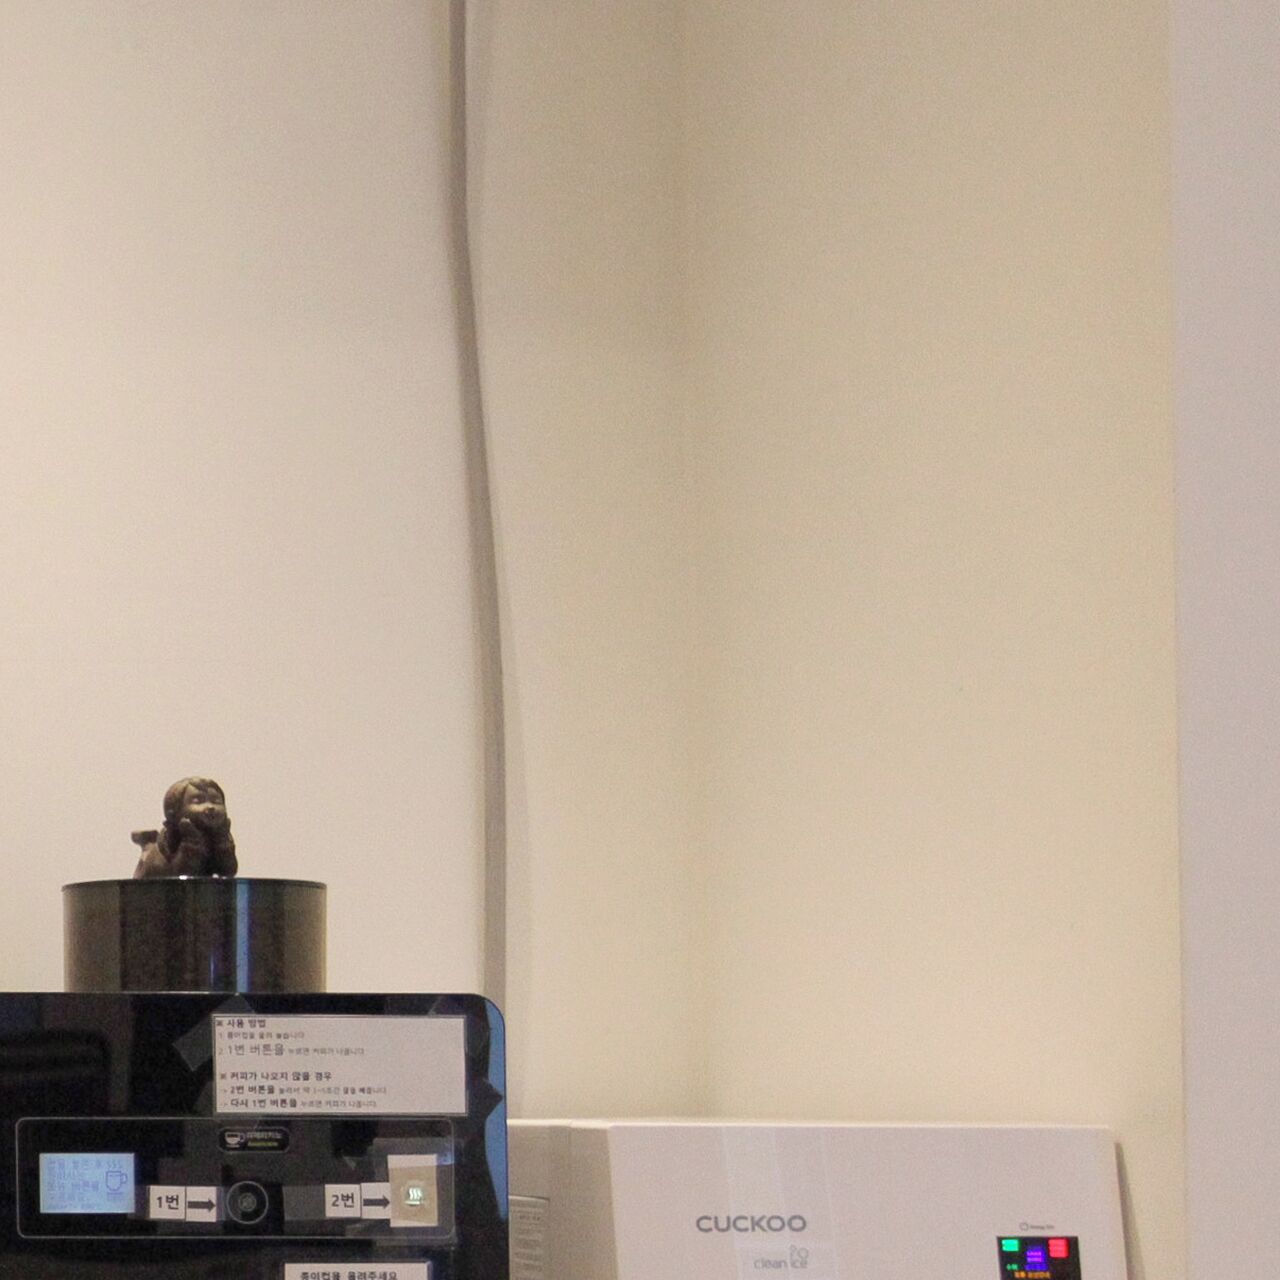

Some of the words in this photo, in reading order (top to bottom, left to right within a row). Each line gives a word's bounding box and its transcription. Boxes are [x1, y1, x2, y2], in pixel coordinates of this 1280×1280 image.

[227, 1018, 244, 1029] 사용
[248, 1018, 267, 1029] 방법
[227, 1043, 245, 1057] 1번
[249, 1042, 284, 1057] 버튼을
[230, 1071, 258, 1081] 커피가
[261, 1071, 289, 1081] 나오지
[315, 1071, 333, 1082] 경우
[230, 1085, 245, 1095] 2번
[248, 1084, 276, 1095] 버튼을
[230, 1098, 249, 1108] 다시
[253, 1098, 267, 1108] 1번
[270, 1098, 298, 1109] 버튼을
[156, 1194, 180, 1211] 1번
[330, 1192, 356, 1209] 2번
[695, 1214, 808, 1233] CUCKOO
[753, 1257, 789, 1270] clean
